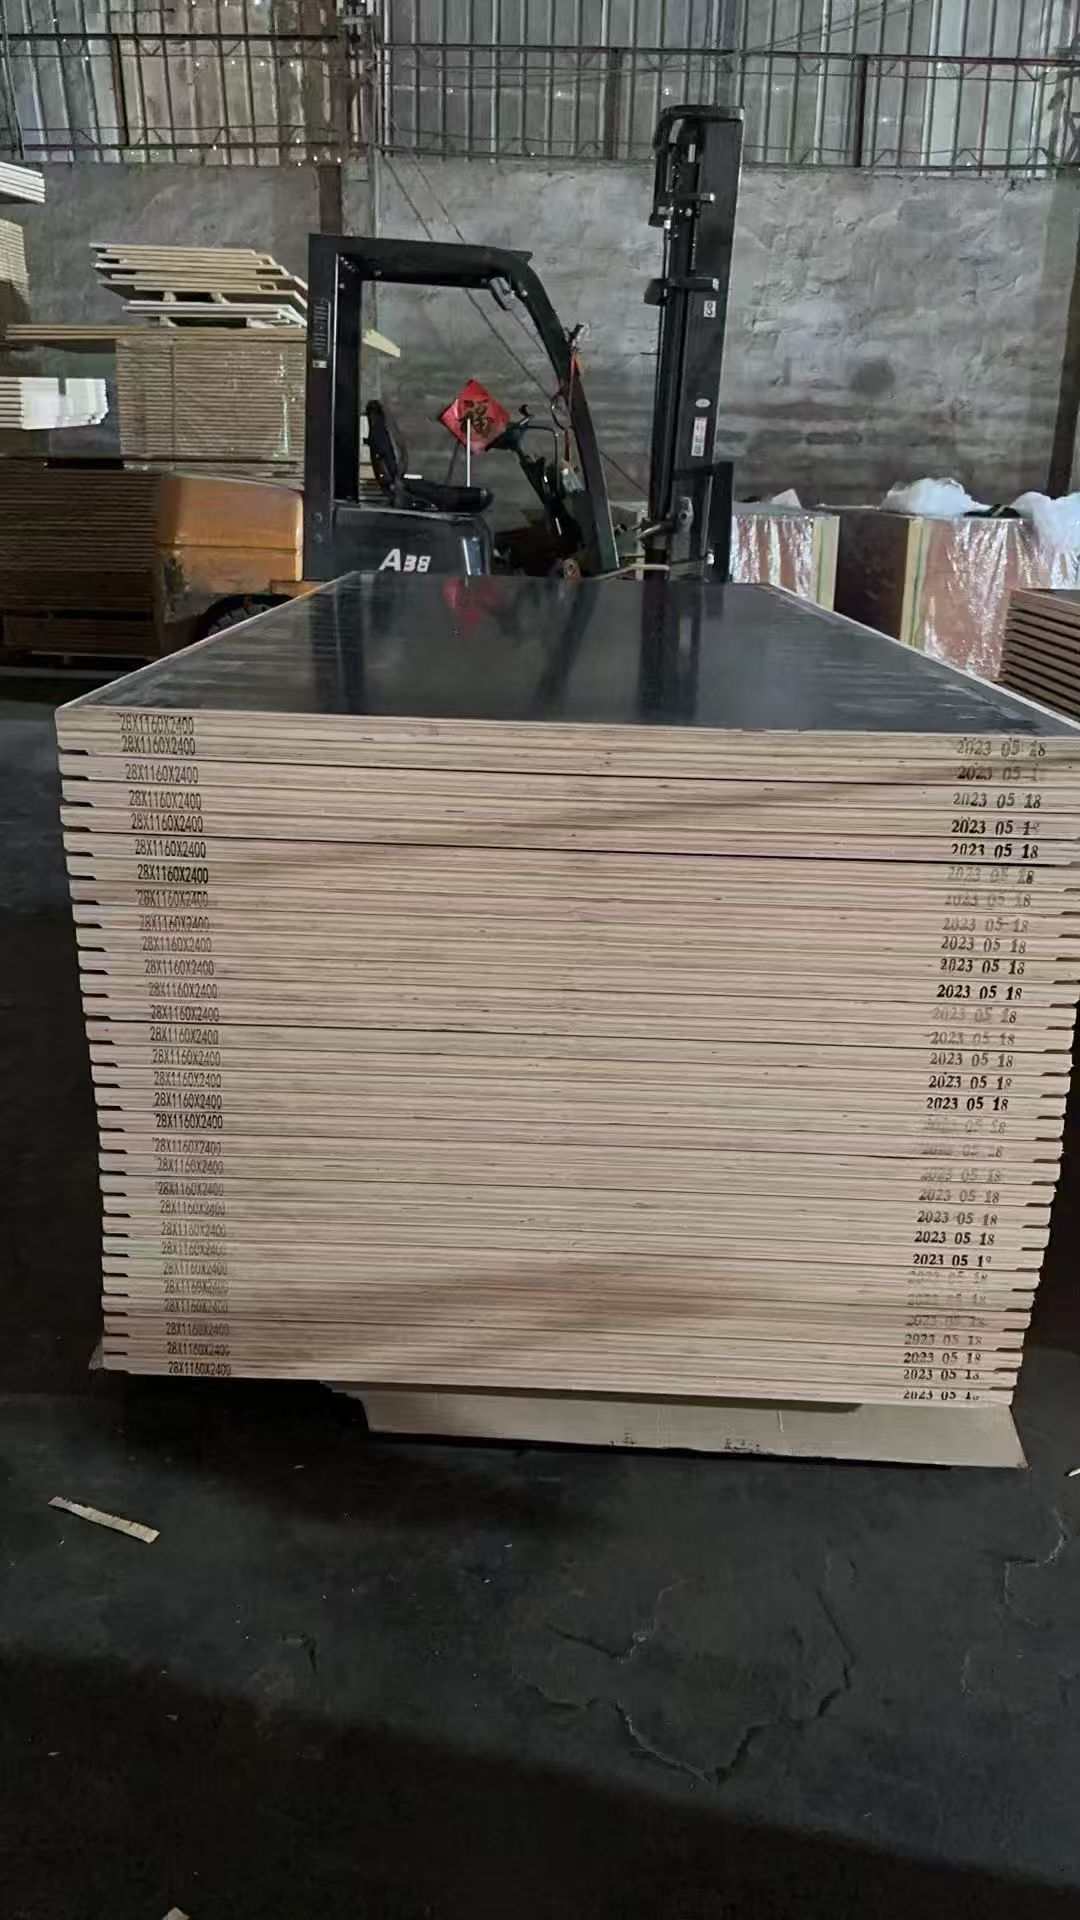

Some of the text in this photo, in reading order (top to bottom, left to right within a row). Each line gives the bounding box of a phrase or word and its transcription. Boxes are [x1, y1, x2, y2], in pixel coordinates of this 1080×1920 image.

[379, 548, 431, 572] A38
[120, 714, 194, 734] 28X1160X2400
[122, 735, 196, 755] 28X1160X2400
[125, 764, 198, 783] 28X1160X2400
[129, 790, 201, 810] 28X1160X2400
[953, 792, 1041, 808] 2023 05 18
[131, 813, 203, 833] 28X1160X2400
[951, 820, 985, 834] 2023
[996, 821, 1013, 834] 05
[135, 839, 206, 858] 28X1160X2400
[951, 844, 1038, 858] 2023 05 18
[138, 864, 208, 883] 28X1160X2400
[943, 918, 1028, 933] 2023 05 18
[142, 936, 212, 952] 28X1160X2400
[941, 937, 1026, 953] 2023 05 18
[145, 959, 214, 976] 28X1160X2400
[940, 959, 1024, 974] 2023 05 18
[149, 982, 217, 998] 28X1160X2400
[937, 985, 1022, 1000] 2023 05 18
[150, 1004, 219, 1022] 28X1160X2400
[150, 1027, 218, 1045] 28X1160X2400
[1001, 1033, 1014, 1045] 18
[152, 1049, 220, 1066] 28X1160X2400
[930, 1053, 1013, 1067] 2023 05 18
[154, 1072, 221, 1088] 28X1160X2400
[928, 1076, 961, 1088] 2023
[971, 1077, 986, 1088] 05
[154, 1092, 222, 1109] 28X1160X2400
[927, 1098, 1008, 1110] 2023 05 18
[155, 1114, 223, 1129] 28X1160X2400
[154, 1138, 221, 1155] 28X1160X2400
[157, 1158, 224, 1174] 28X1160X2400
[960, 1191, 976, 1202] 05
[985, 1191, 999, 1203] 18
[917, 1212, 997, 1225] 2023 05 18
[914, 1232, 994, 1245] 2023 05 18
[913, 1254, 944, 1265] 2023
[952, 1255, 968, 1266] 05
[905, 1334, 935, 1345] 2023
[167, 1342, 230, 1356] 28X1160X2400
[904, 1353, 981, 1364] 2023 05 18
[169, 1361, 231, 1376] 28X1160X2400
[904, 1369, 933, 1380] 2023
[941, 1369, 956, 1380] 05
